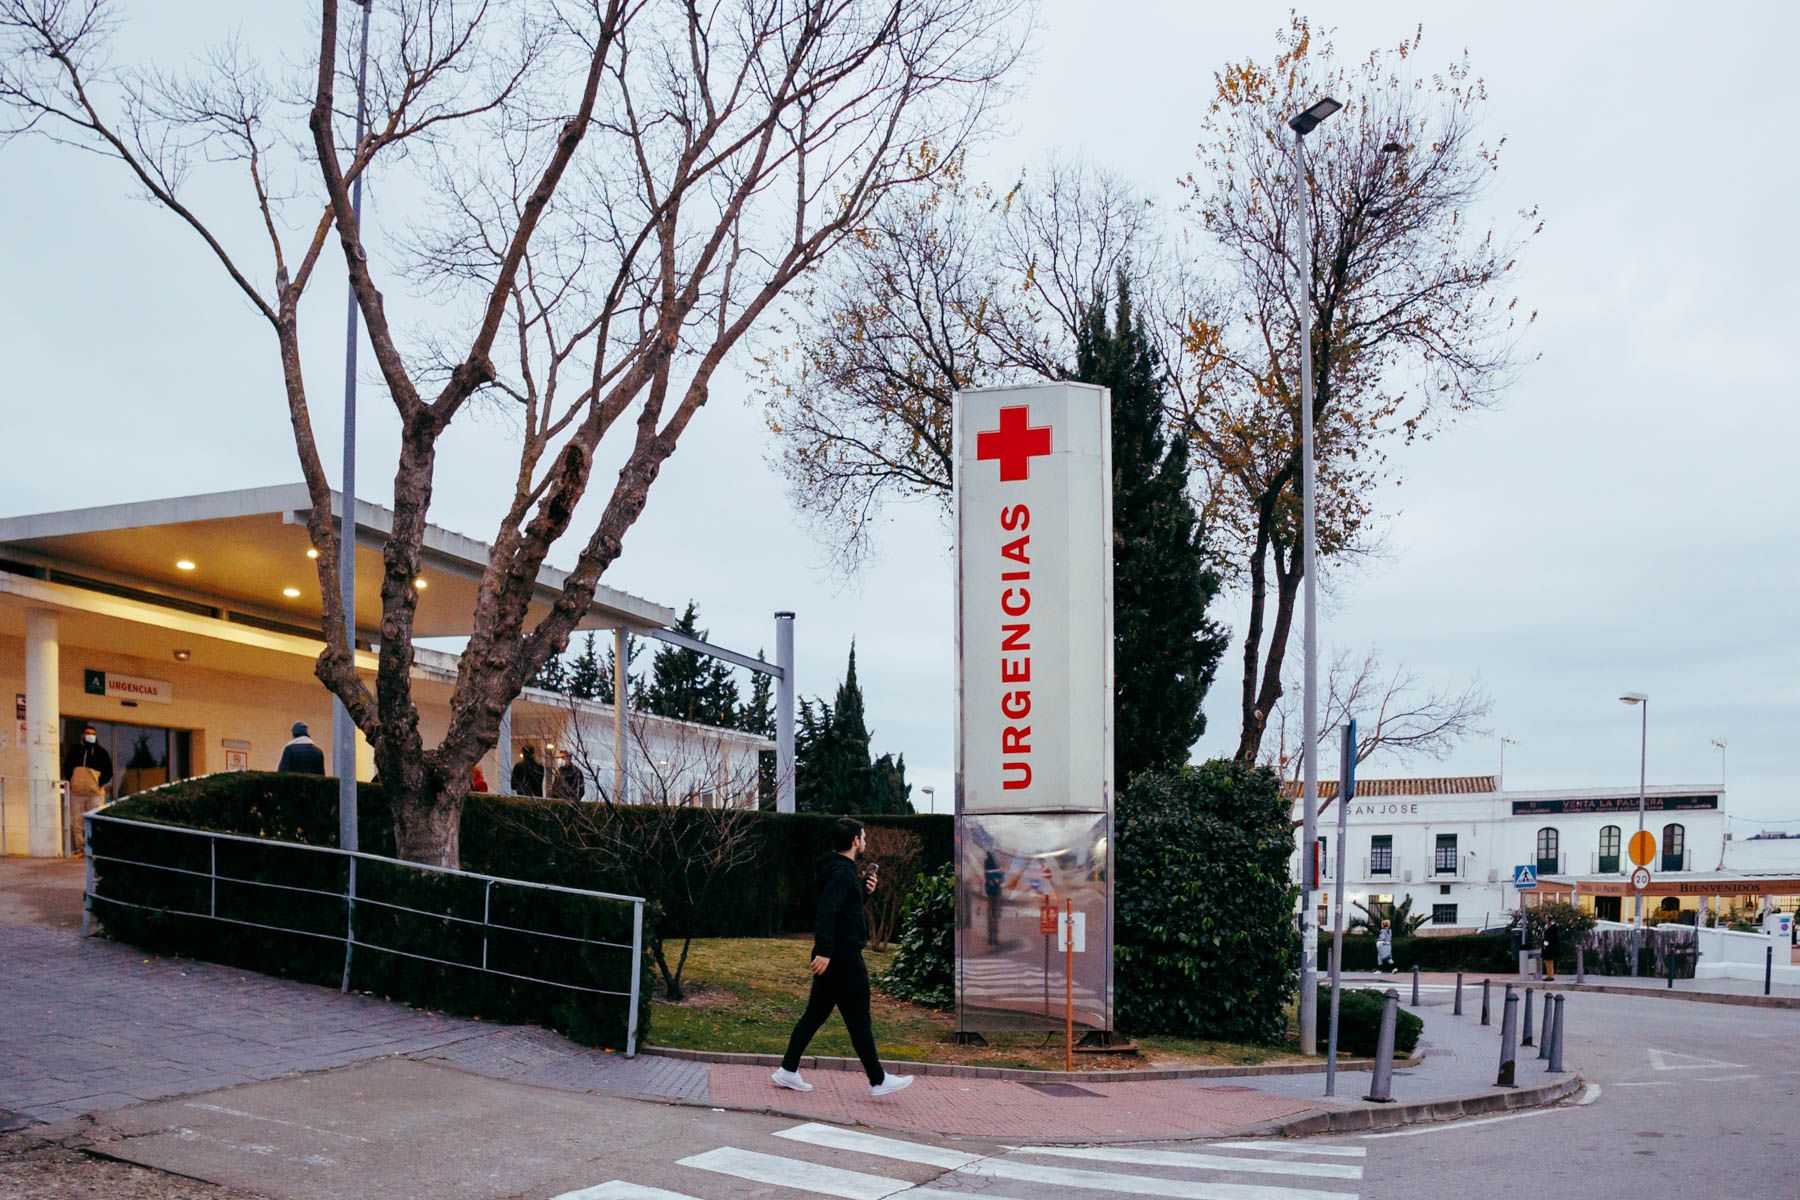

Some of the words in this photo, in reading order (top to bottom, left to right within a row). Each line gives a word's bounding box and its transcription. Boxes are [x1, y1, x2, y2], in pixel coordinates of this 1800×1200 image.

[1000, 503, 1032, 790] URGENCIAS
[108, 680, 158, 695] URGENCIAS
[1563, 800, 1595, 808] VENTA
[1600, 799, 1613, 807] LA
[1346, 805, 1375, 816] SAN
[1636, 875, 1648, 884] 20
[1680, 883, 1761, 892] BIENVENIDOS
